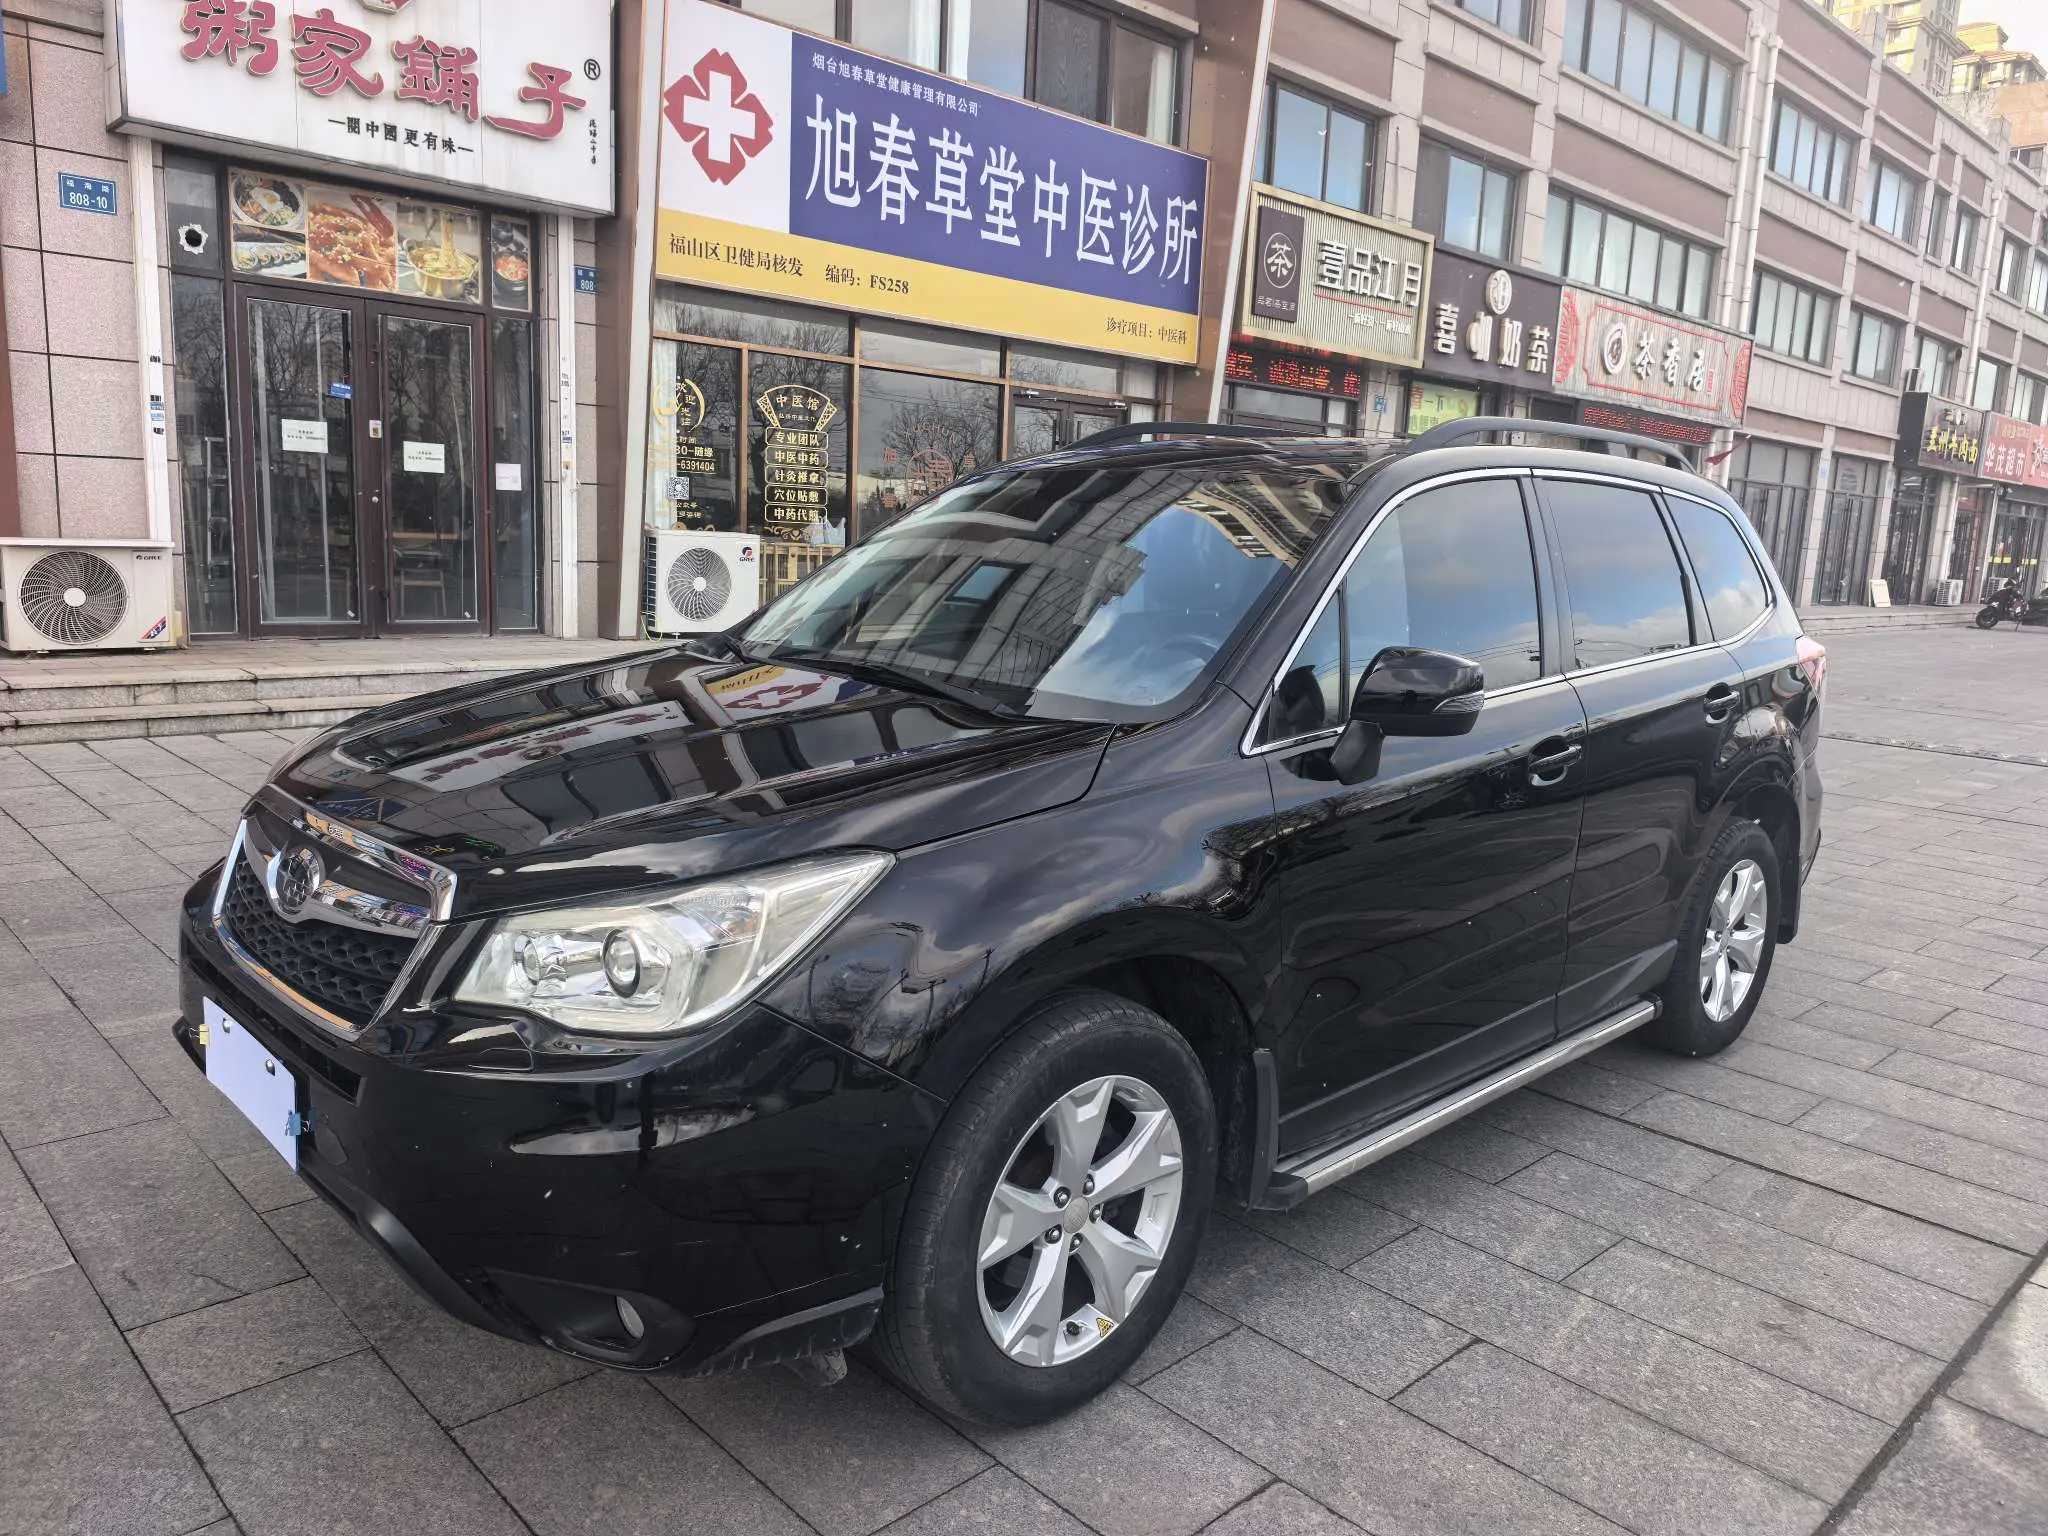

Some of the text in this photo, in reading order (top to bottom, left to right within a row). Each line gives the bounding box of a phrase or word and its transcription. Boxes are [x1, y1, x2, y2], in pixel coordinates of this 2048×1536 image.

[811, 51, 981, 117] 烟台旭春草堂健康管理有限公司
[804, 93, 1199, 287] 旭春草堂中医诊所
[69, 192, 108, 209] 808-10
[668, 231, 804, 279] 福山区卫健局核发
[1267, 242, 1294, 278] 茶
[776, 394, 820, 412] 中医馆
[775, 431, 820, 447] 专业团队
[775, 450, 820, 466] 中医中药
[774, 469, 821, 484] 针灸推拿
